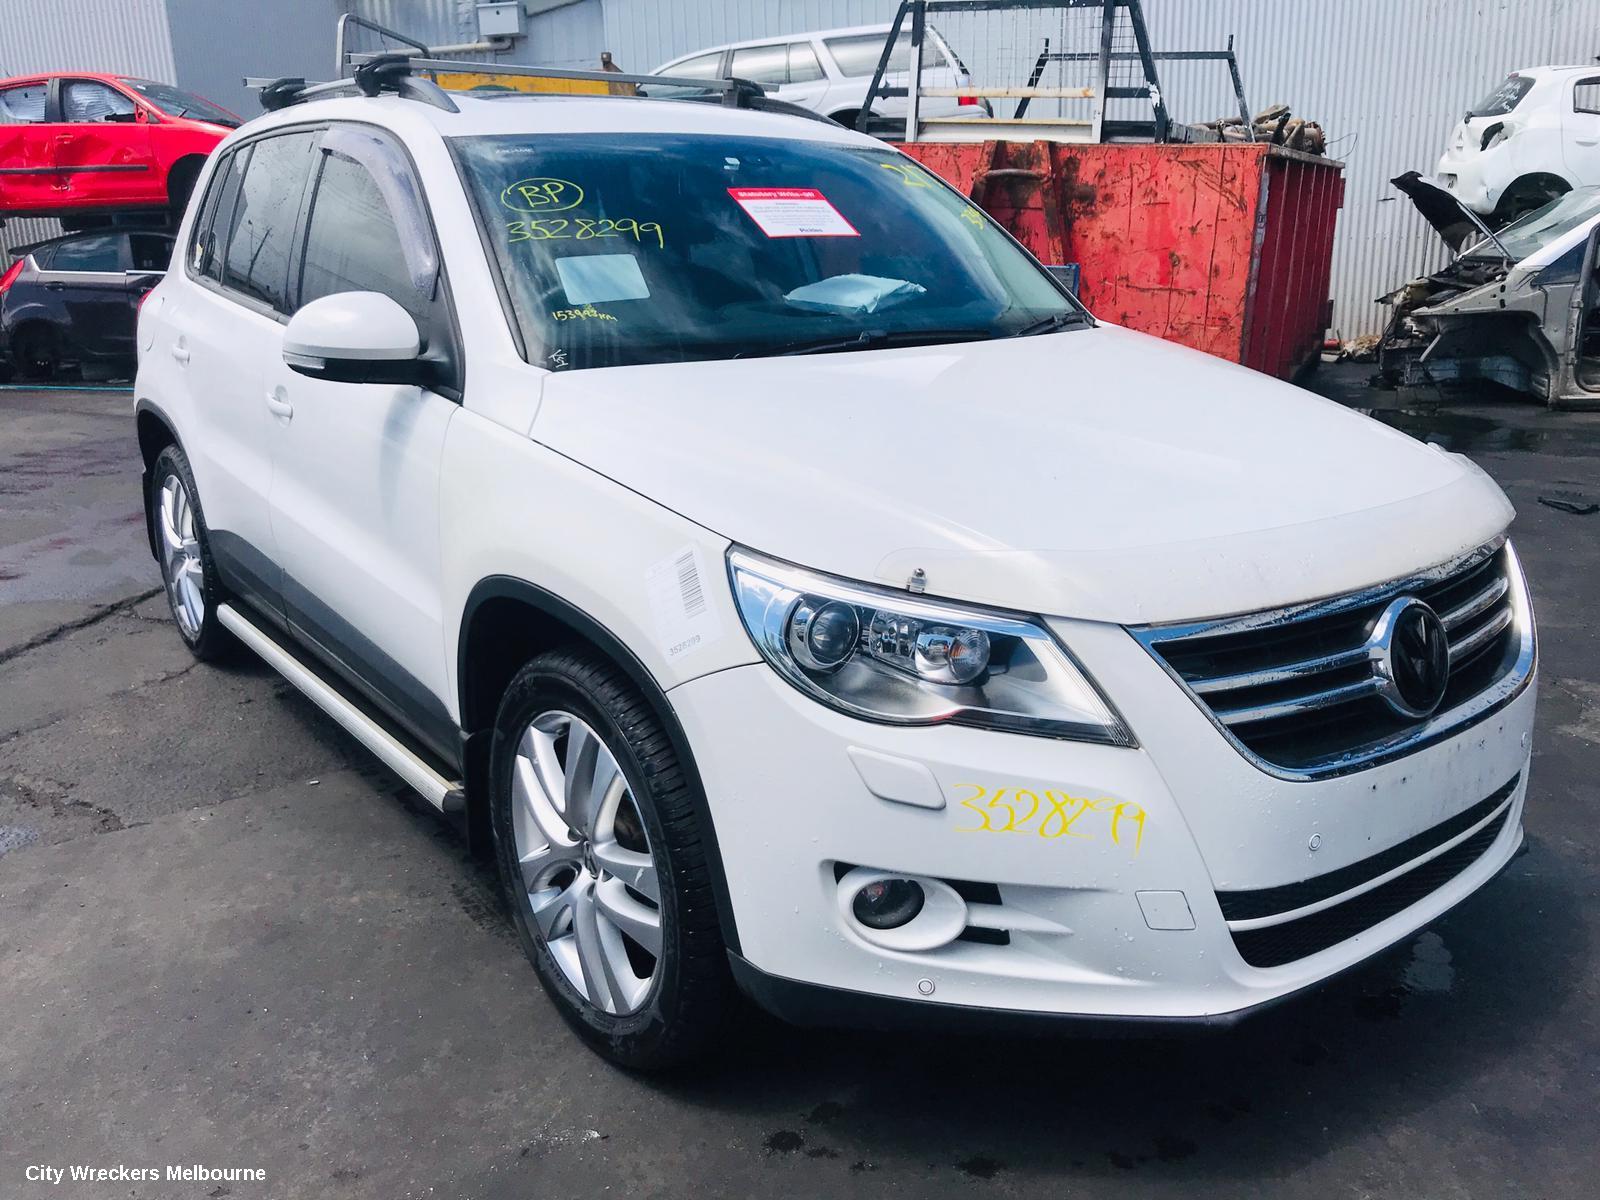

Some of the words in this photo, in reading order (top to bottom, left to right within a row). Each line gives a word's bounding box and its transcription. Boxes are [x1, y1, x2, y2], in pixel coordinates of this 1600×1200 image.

[518, 181, 565, 208] BP
[506, 217, 665, 249] 3528299
[953, 782, 1147, 858] 3528299
